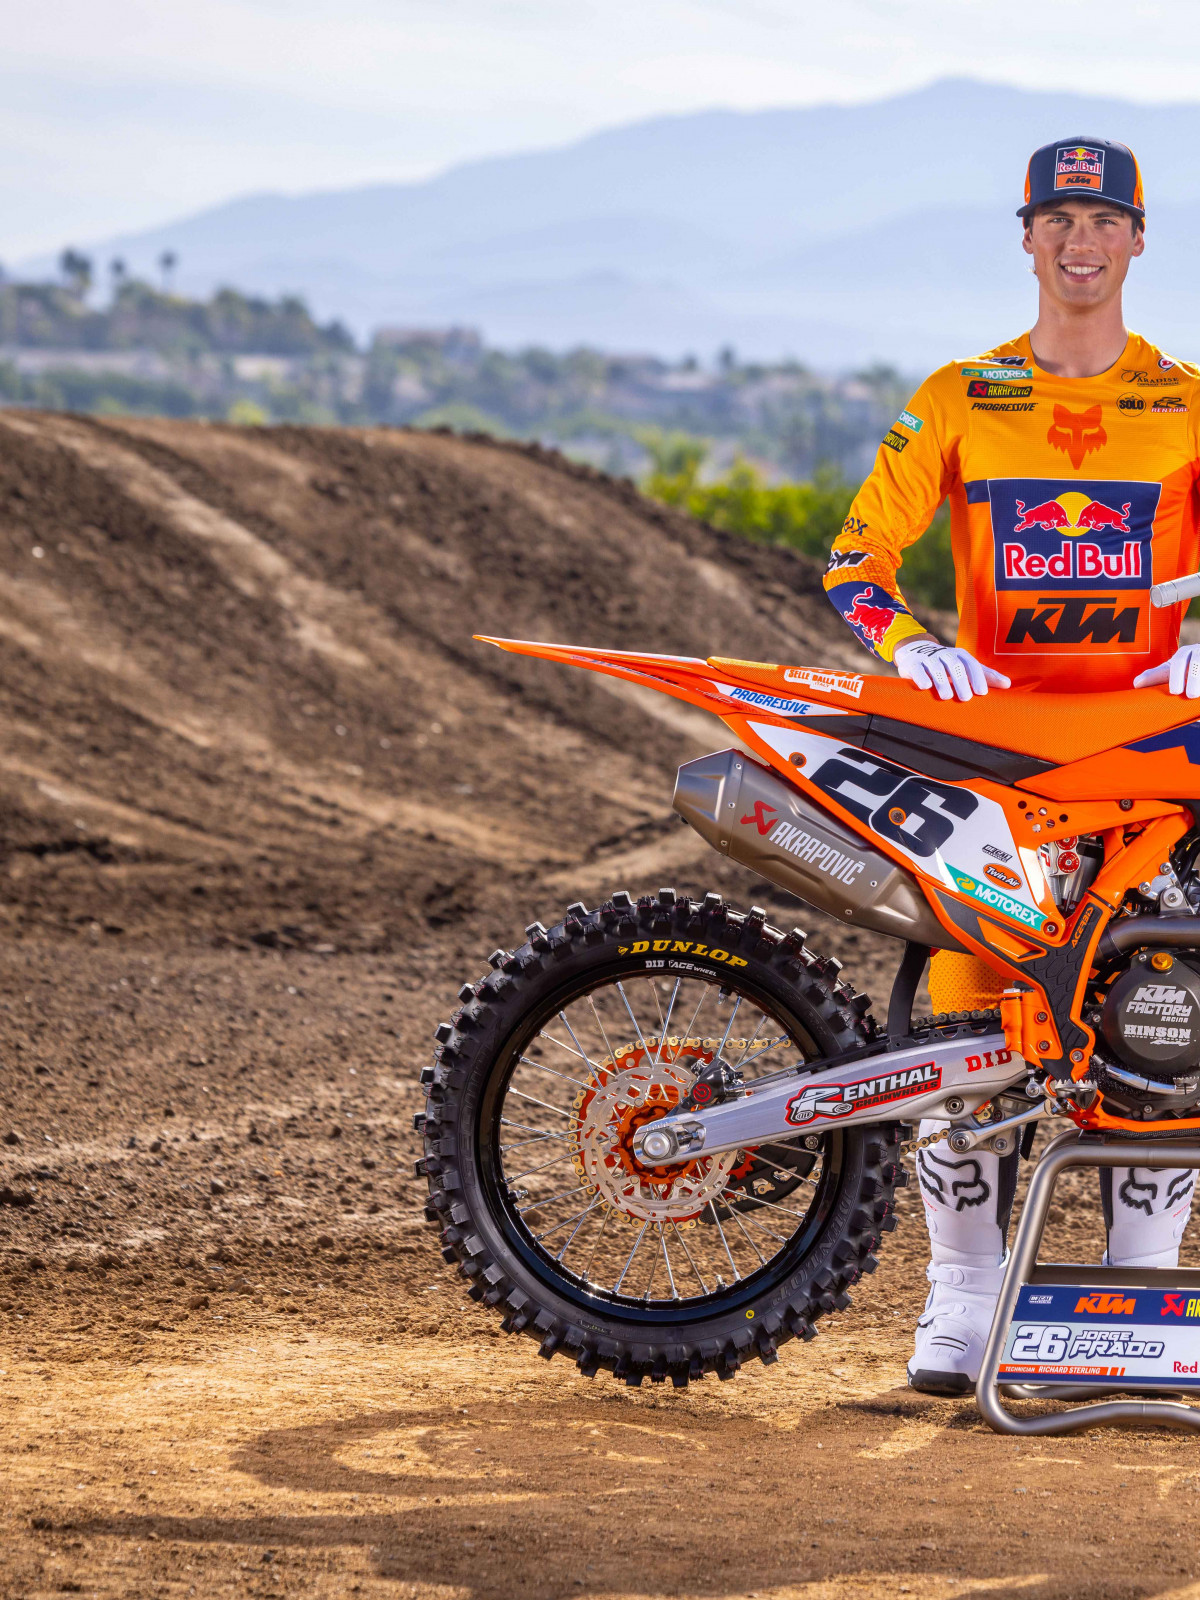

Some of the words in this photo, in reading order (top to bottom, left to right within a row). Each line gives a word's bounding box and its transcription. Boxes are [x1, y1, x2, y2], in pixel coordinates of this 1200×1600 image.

[1057, 161, 1080, 173] Red
[1080, 162, 1102, 174] Bull
[1065, 175, 1092, 185] KTM
[982, 370, 1028, 379] MOTOREX
[971, 402, 1038, 412] PROGRESSIVE
[1119, 399, 1144, 410] SOLO
[1003, 541, 1073, 579] Red
[1077, 541, 1142, 579] Bull
[1004, 597, 1140, 643] KTM
[788, 670, 810, 680] SELLE
[837, 679, 860, 693] VALLE
[730, 687, 811, 715] PROGRESSIVE
[807, 747, 979, 858] 26
[985, 865, 1007, 882] Twin
[1005, 876, 1021, 888] Air
[973, 884, 1038, 927] MOTOREX
[630, 940, 748, 967] DUNLOP
[1133, 984, 1187, 1004] KTM
[1126, 1001, 1193, 1017] FACTORY
[1123, 1024, 1192, 1039] HINSON
[855, 1081, 938, 1109] CHAINWHEELS
[1074, 1292, 1136, 1315] KTM
[1010, 1324, 1072, 1362] 26
[1073, 1330, 1134, 1342] JORGE
[1068, 1340, 1165, 1360] PRADO
[1038, 1365, 1069, 1374] RICHARD
[1069, 1367, 1101, 1375] STERLING
[1173, 1361, 1198, 1374] Red
